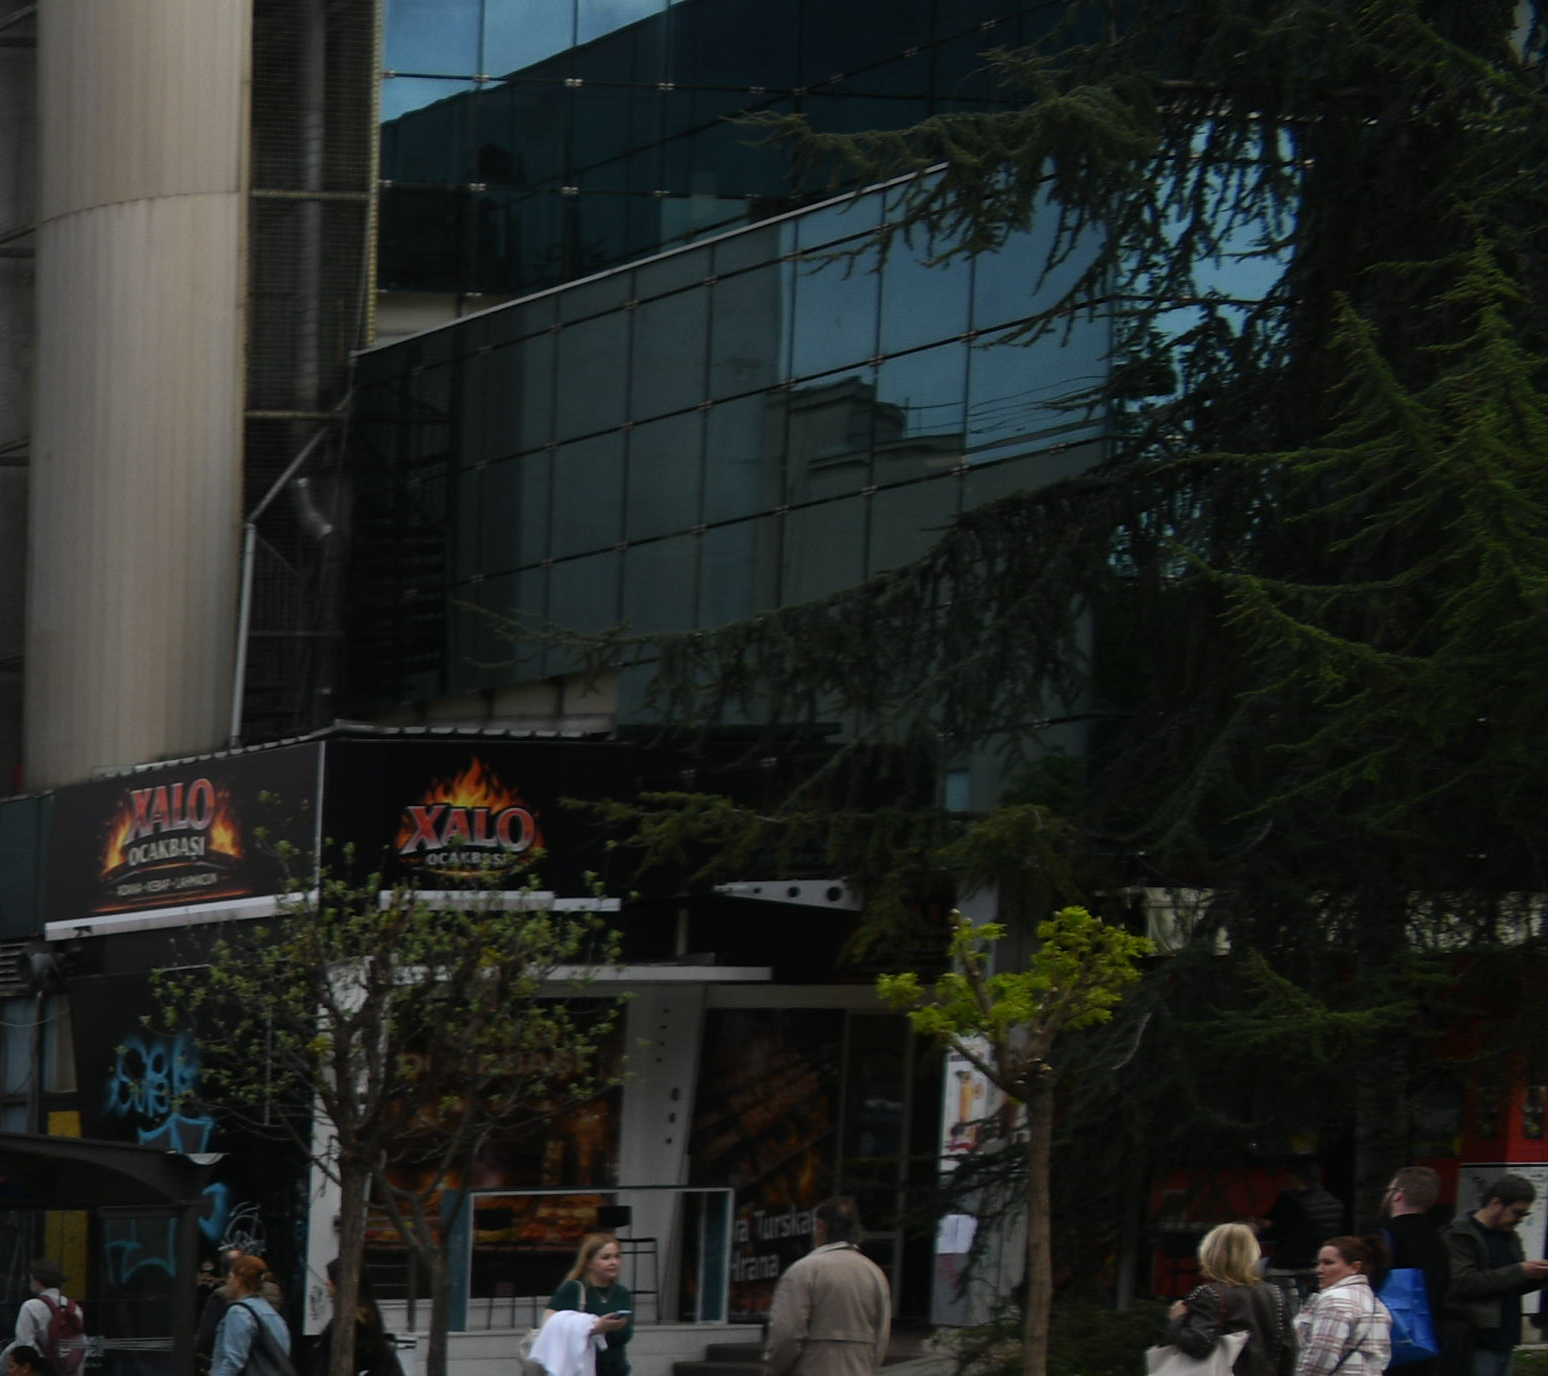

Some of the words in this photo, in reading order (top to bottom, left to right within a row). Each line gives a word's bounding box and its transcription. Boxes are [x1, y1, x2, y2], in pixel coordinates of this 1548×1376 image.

[125, 778, 216, 844] XALO
[397, 804, 536, 855] XALO
[127, 834, 206, 867] OCAKBAŞI
[753, 1203, 812, 1240] Turska
